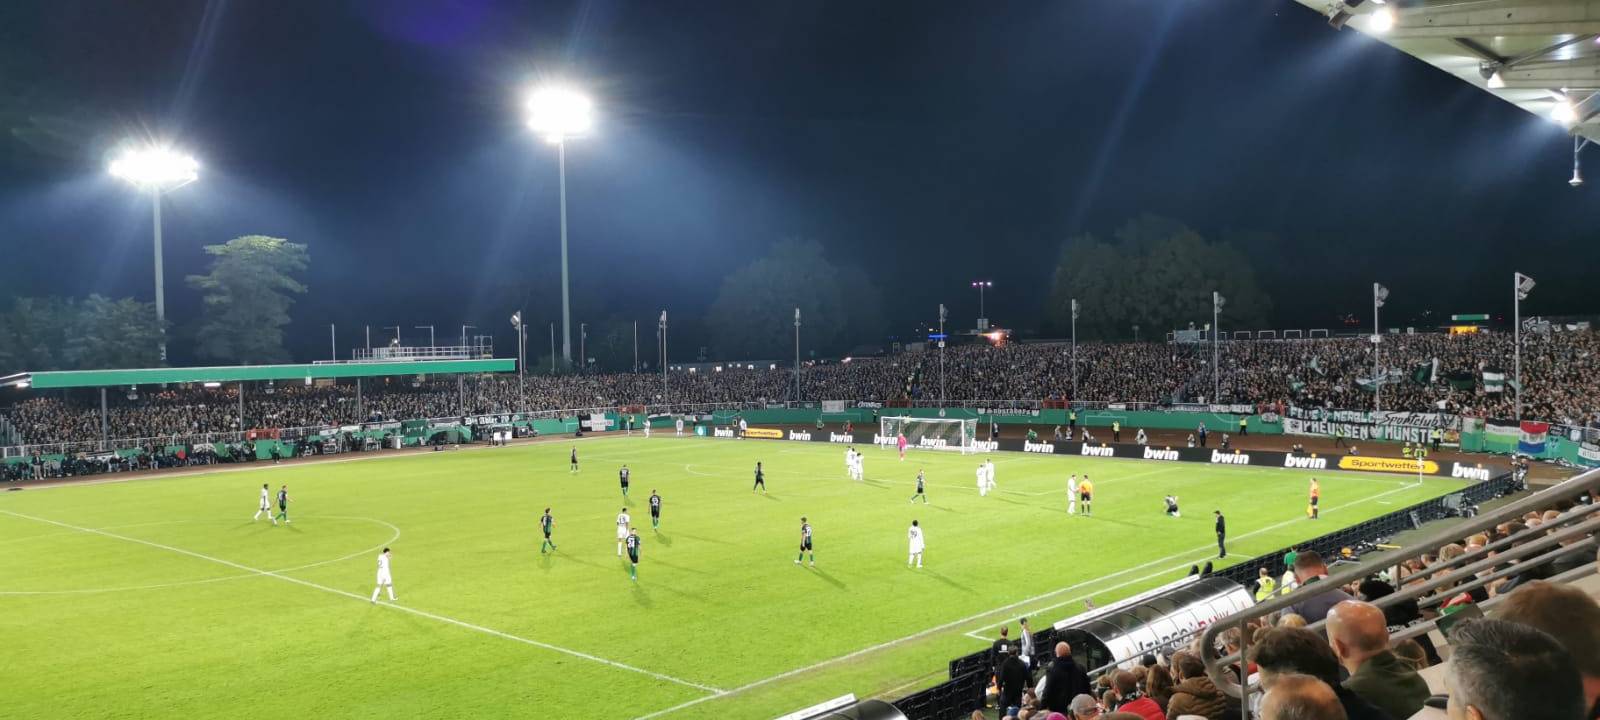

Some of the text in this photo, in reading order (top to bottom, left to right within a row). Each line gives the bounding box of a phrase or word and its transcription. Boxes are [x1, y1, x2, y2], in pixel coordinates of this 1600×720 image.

[1382, 411, 1439, 428] Sportclub
[714, 427, 734, 437] bwin
[789, 430, 811, 441] bwin
[1303, 419, 1369, 440] PREUSEN
[830, 431, 853, 443] bwin
[873, 433, 898, 445] bwin
[920, 436, 947, 448] bwin
[970, 437, 999, 450] bwin
[1023, 440, 1055, 453] bwin
[1081, 443, 1114, 457] bwin
[1143, 446, 1179, 460] bwin
[1211, 449, 1250, 465] bwin
[1284, 453, 1327, 469] bwin
[1351, 459, 1425, 471] Sportwetten
[1452, 462, 1490, 481] bwin
